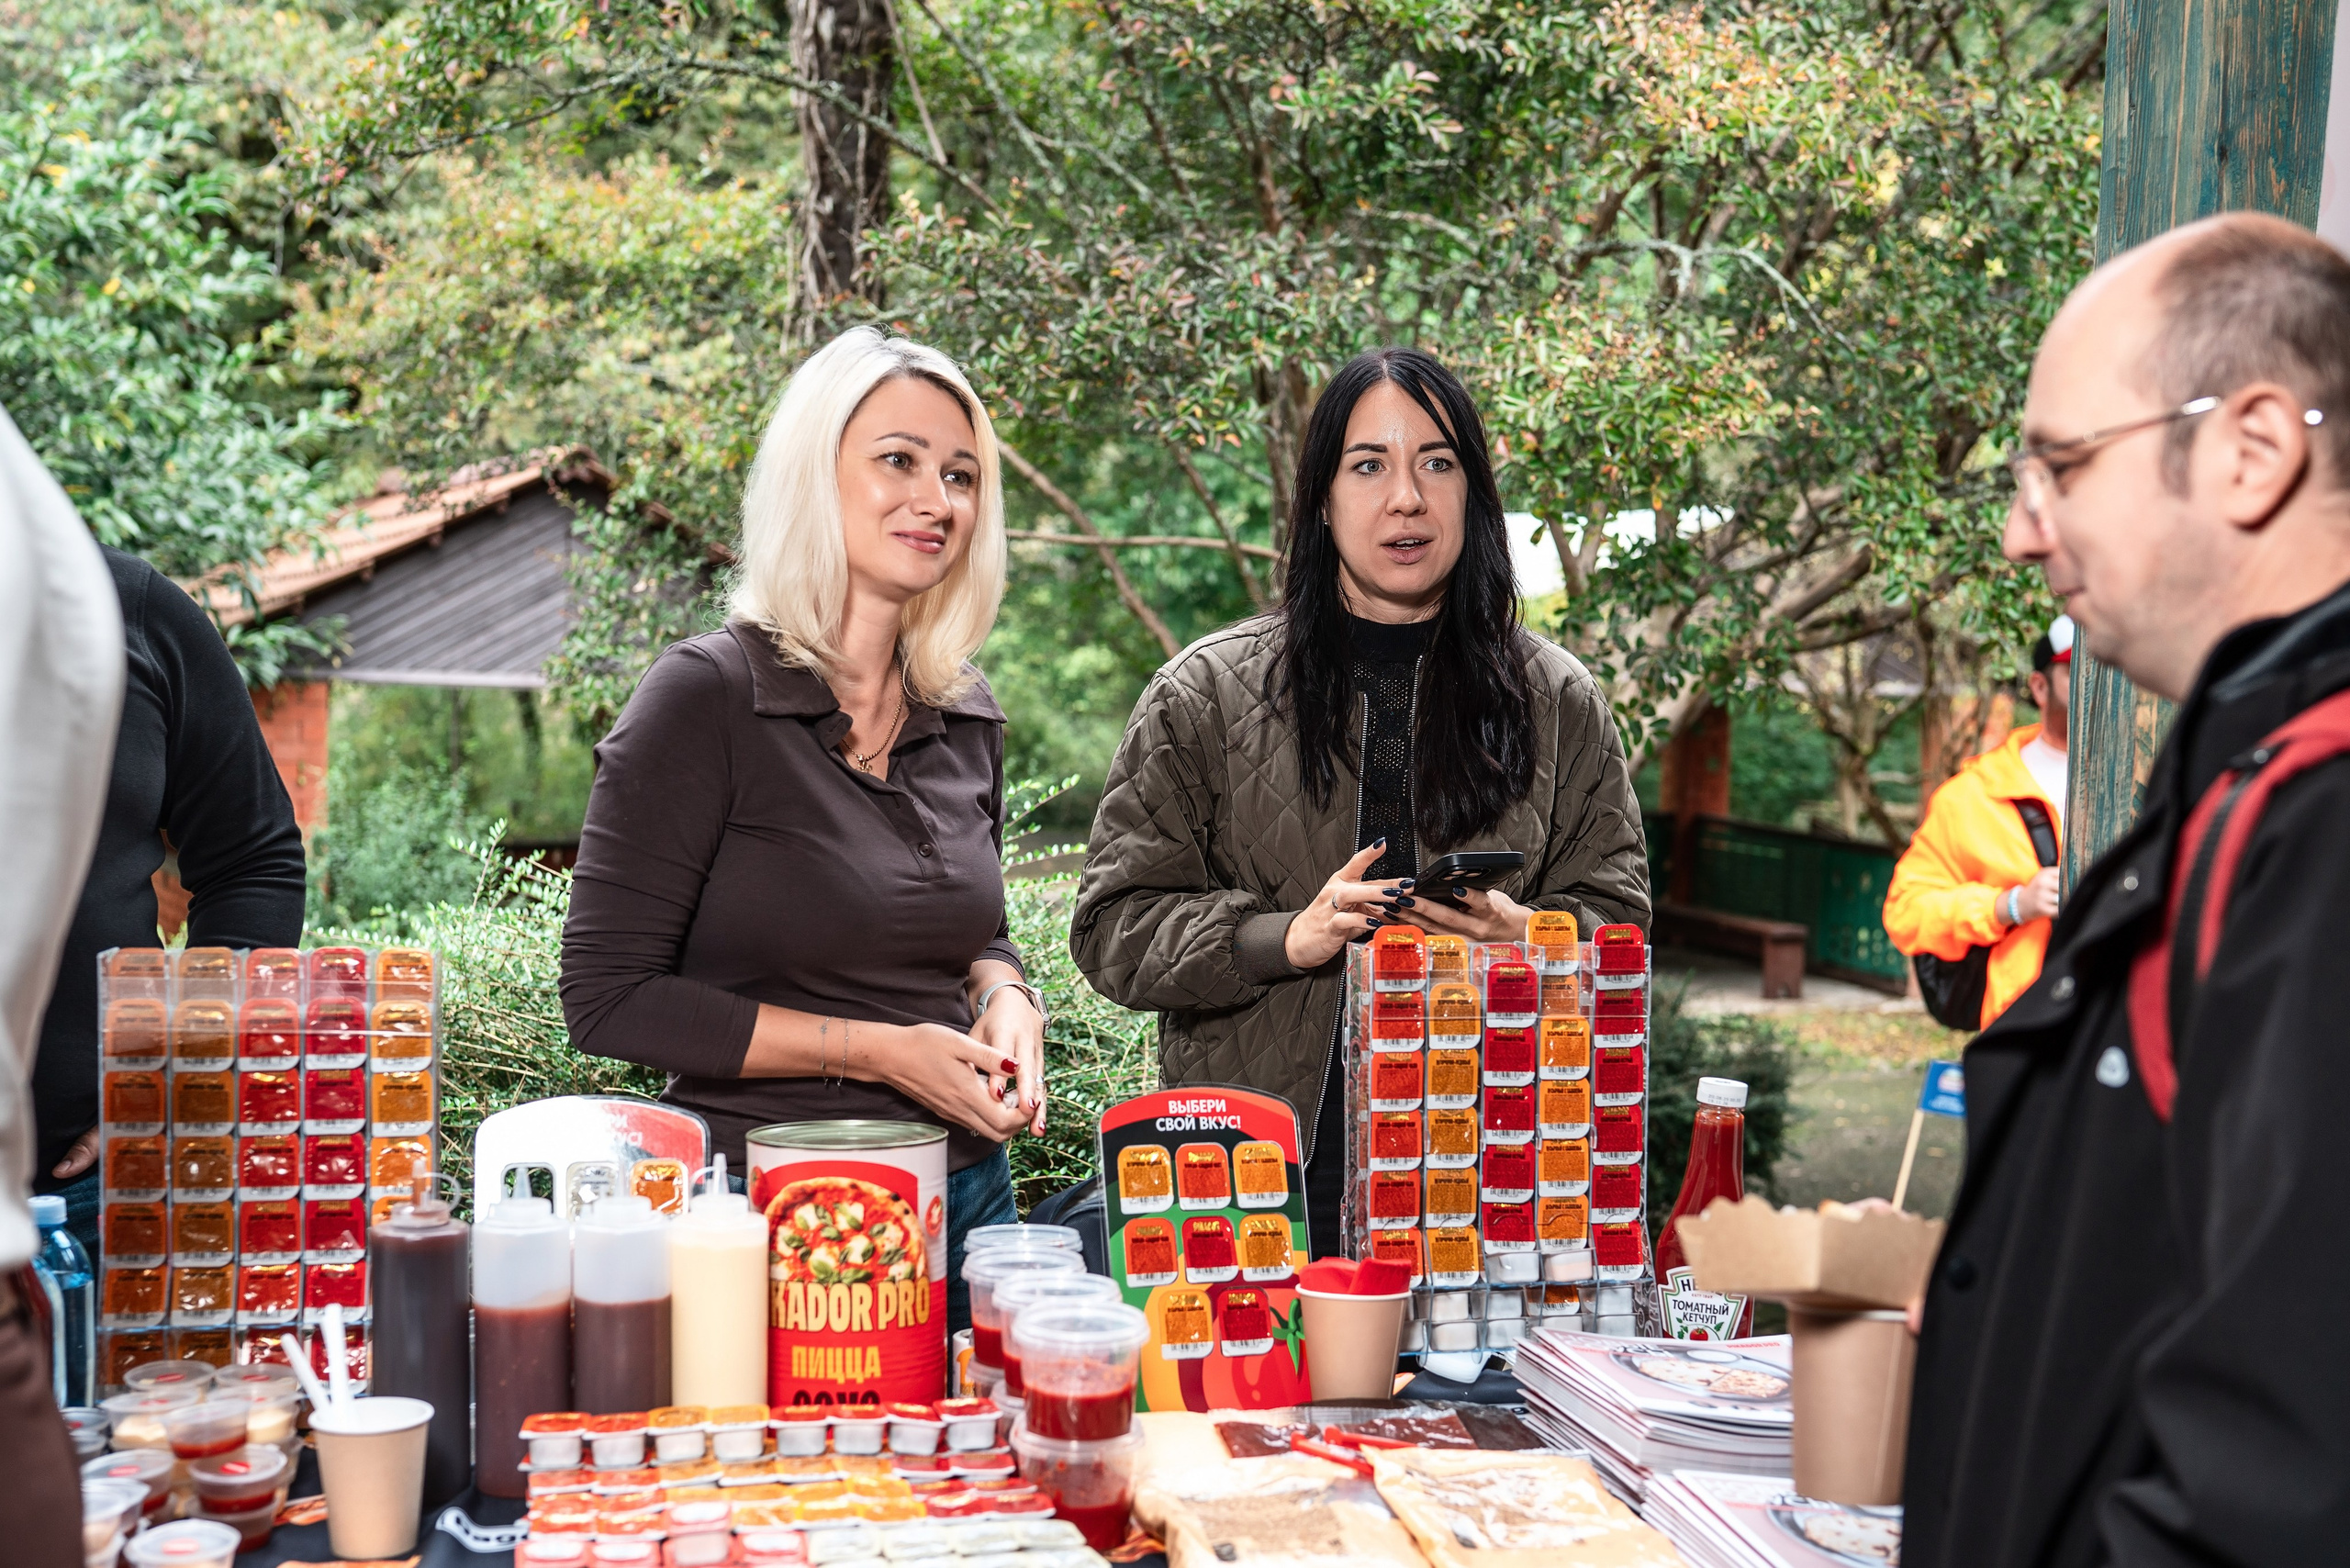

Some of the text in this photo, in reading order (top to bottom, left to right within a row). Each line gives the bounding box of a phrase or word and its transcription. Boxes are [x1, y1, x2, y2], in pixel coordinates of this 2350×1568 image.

[1168, 1099, 1226, 1114] ВЫБЕРИ
[1156, 1114, 1241, 1132] СВОЙ ВКУС!
[878, 1275, 931, 1331] PRO
[1673, 1299, 1729, 1316] ТОМАТНЫЙ
[1683, 1312, 1717, 1325] КЕТЧУП
[791, 1345, 882, 1384] ПИЦЦА
